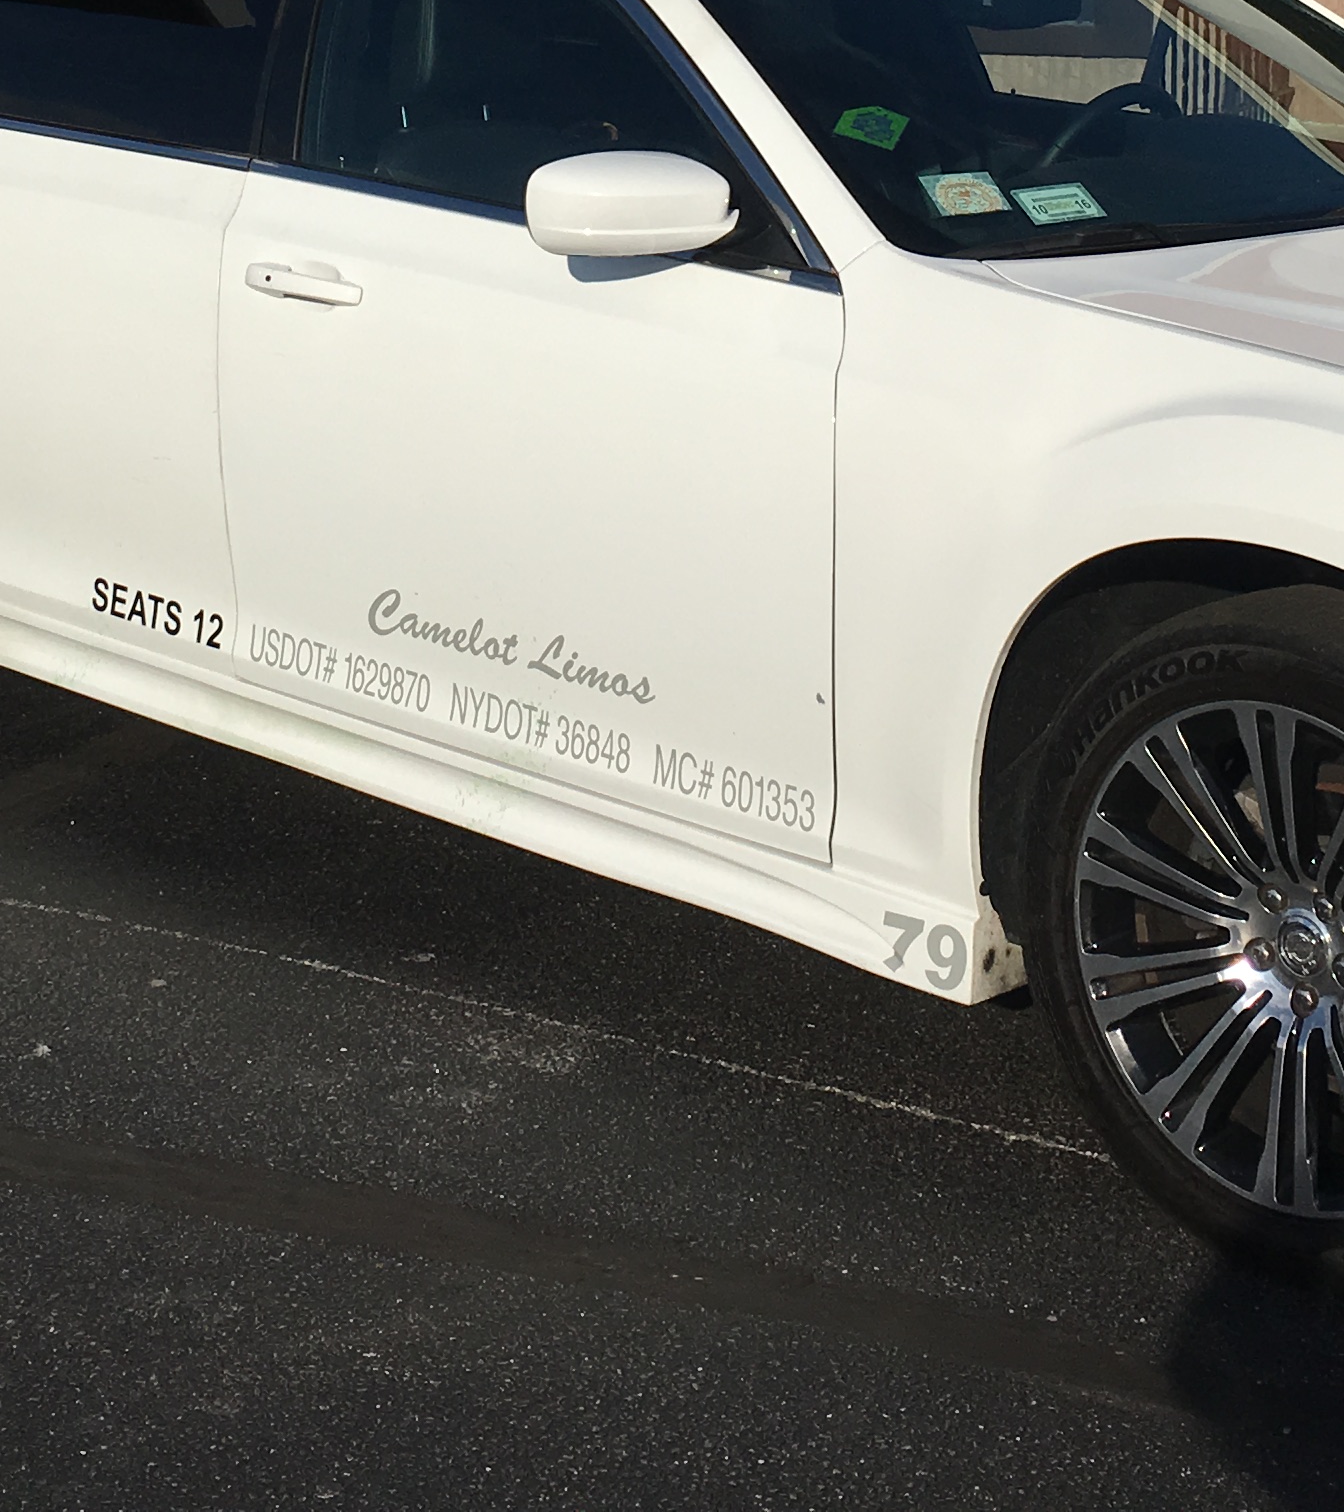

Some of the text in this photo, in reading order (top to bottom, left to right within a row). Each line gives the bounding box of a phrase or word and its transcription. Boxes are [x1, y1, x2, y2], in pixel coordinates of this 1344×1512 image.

[1032, 204, 1048, 215] 10
[1075, 199, 1092, 209] 16
[92, 577, 224, 650] SEATS 12
[368, 588, 656, 704] Camelot Limos
[249, 624, 816, 832] USDOT# 1629870 NYDOT# 36848 MC# 601353
[880, 910, 969, 991] 79
